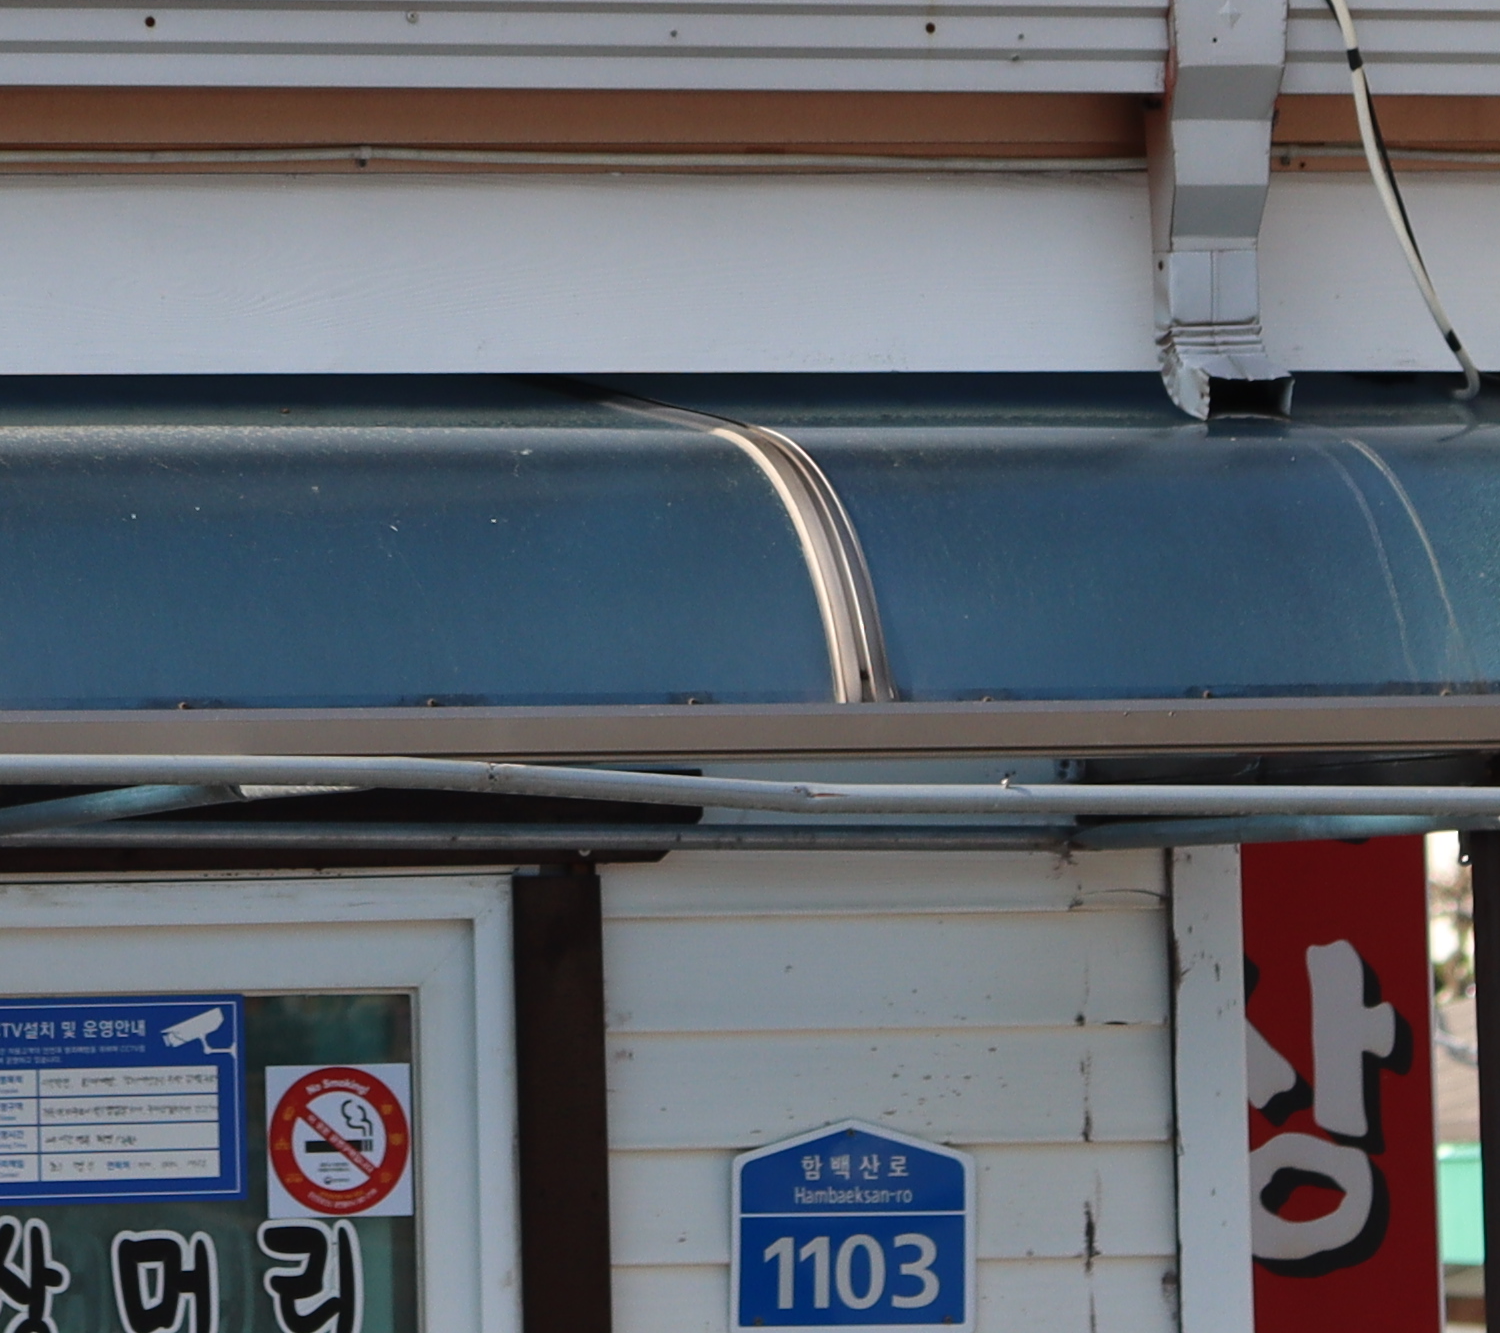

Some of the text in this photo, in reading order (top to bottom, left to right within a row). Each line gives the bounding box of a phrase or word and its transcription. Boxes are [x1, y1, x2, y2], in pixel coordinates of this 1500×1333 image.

[61, 1021, 77, 1039] 및
[82, 1019, 147, 1039] 운영안내
[801, 1154, 910, 1181] 함백산로
[794, 1186, 913, 1205] Hambaeksan-ro
[762, 1232, 941, 1311] 1103
